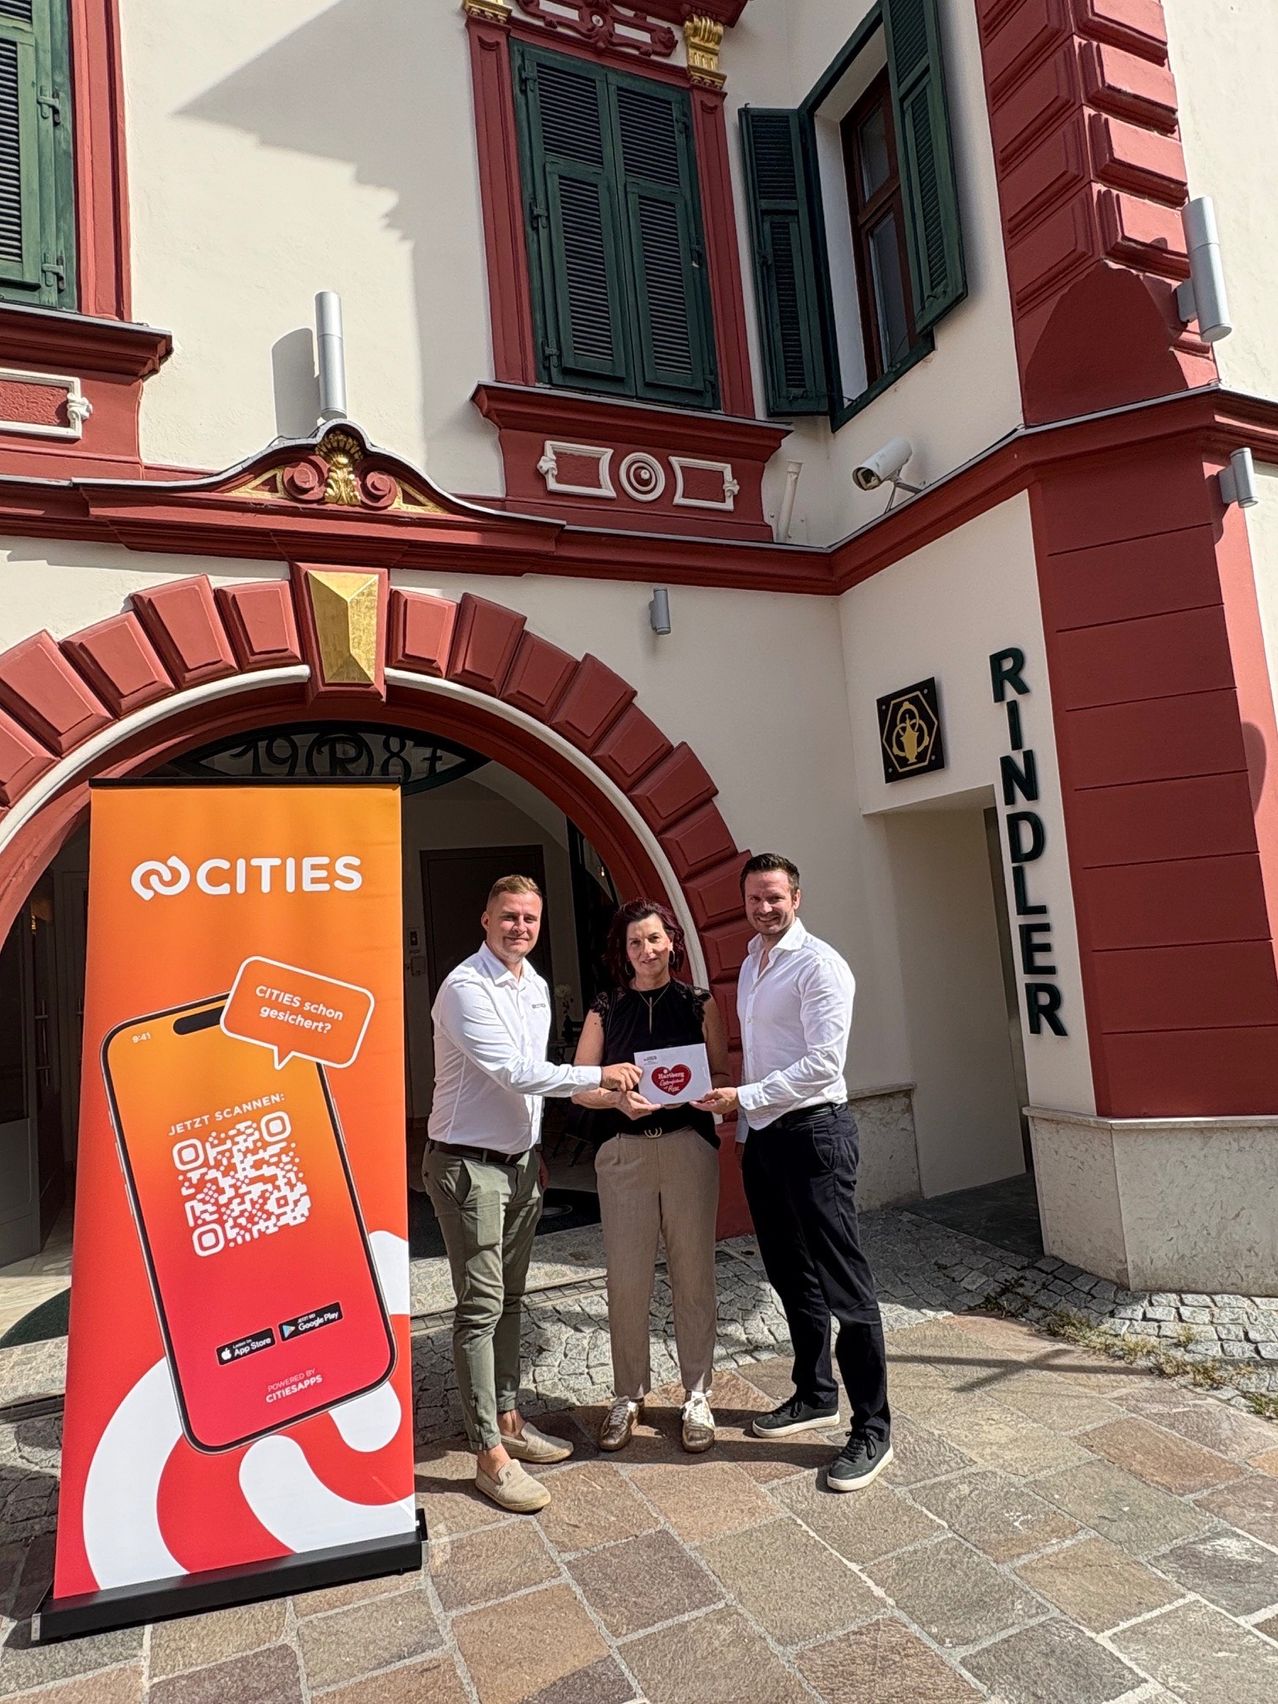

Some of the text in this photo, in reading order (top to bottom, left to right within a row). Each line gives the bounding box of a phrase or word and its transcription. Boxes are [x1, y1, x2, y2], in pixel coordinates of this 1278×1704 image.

[988, 646, 1069, 1037] RINDLER
[196, 855, 363, 895] CITIES
[255, 985, 343, 1021] CITIES schon
[259, 1004, 332, 1035] gesichert?
[132, 1031, 151, 1044] 9:41
[168, 1093, 285, 1136] JETZT SCANNEN:
[298, 1311, 339, 1331] Google Play
[234, 1337, 271, 1357] App Store
[265, 1374, 323, 1403] CITIESAPPS
[267, 1367, 316, 1392] POWERED BY
